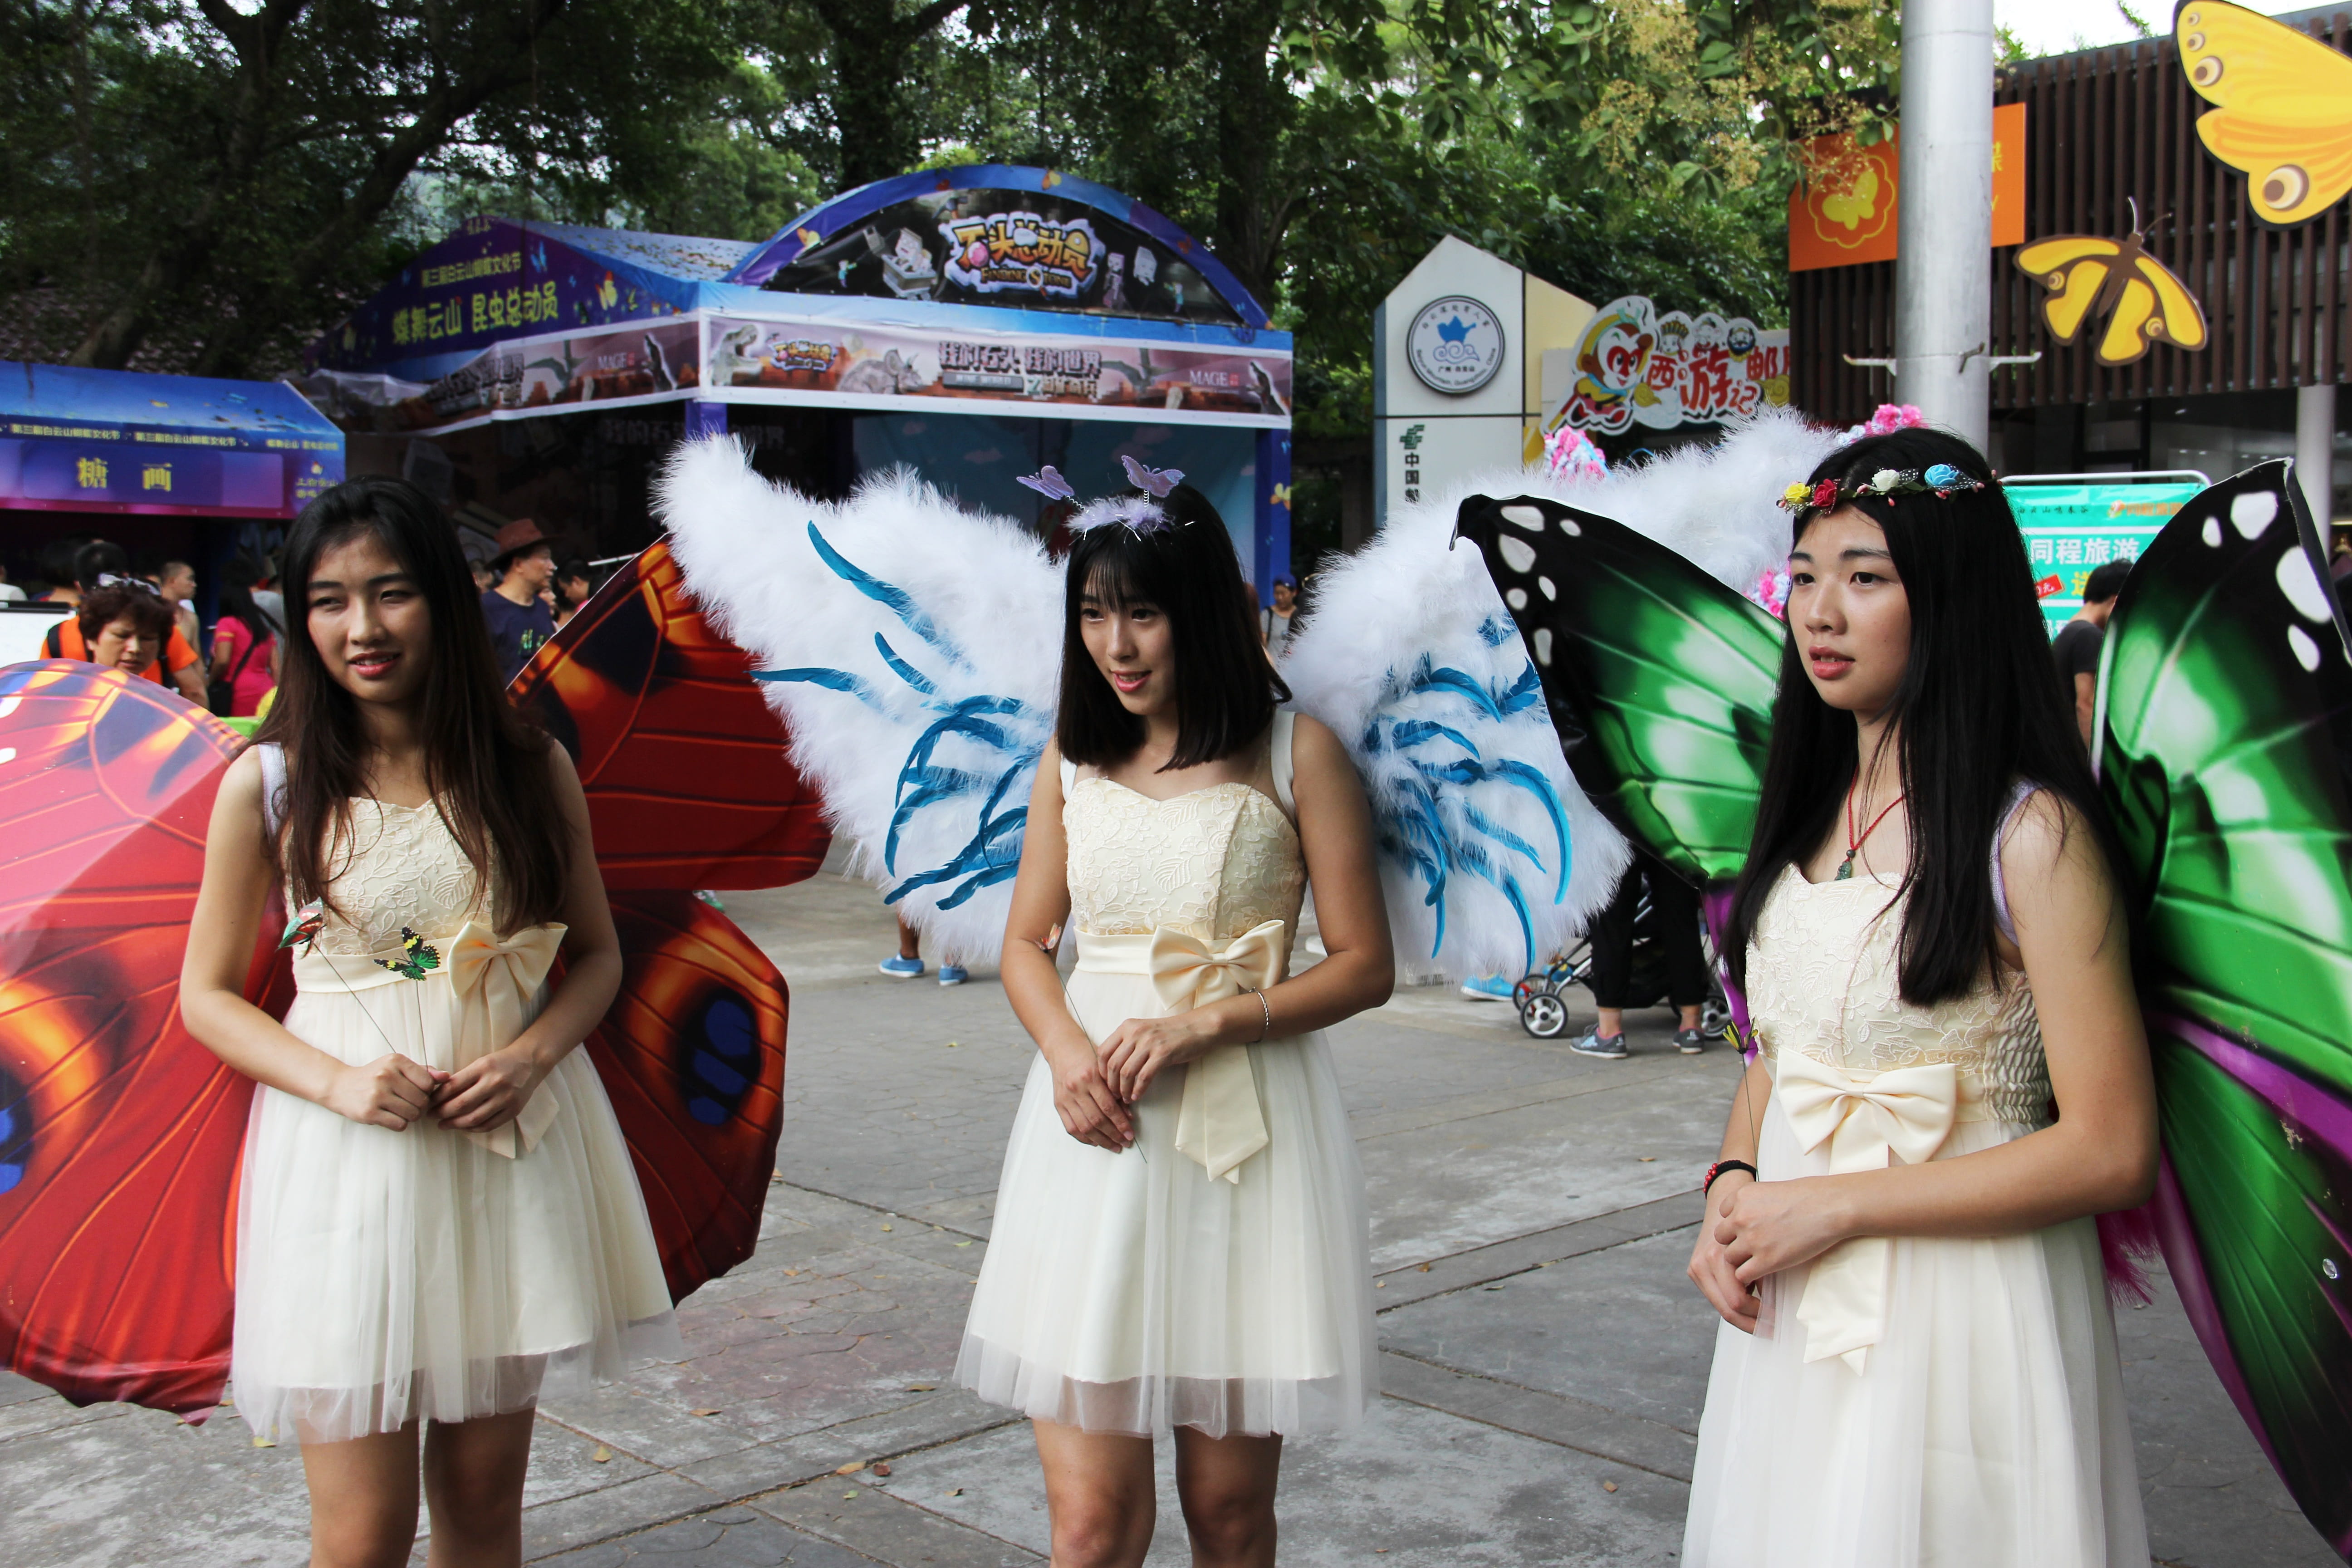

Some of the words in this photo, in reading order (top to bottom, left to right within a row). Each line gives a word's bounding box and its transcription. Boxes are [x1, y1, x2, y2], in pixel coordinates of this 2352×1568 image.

[471, 280, 559, 333] 昆虫总动员
[1189, 370, 1228, 387] MAGE
[2030, 538, 2140, 565] 同程旅游
